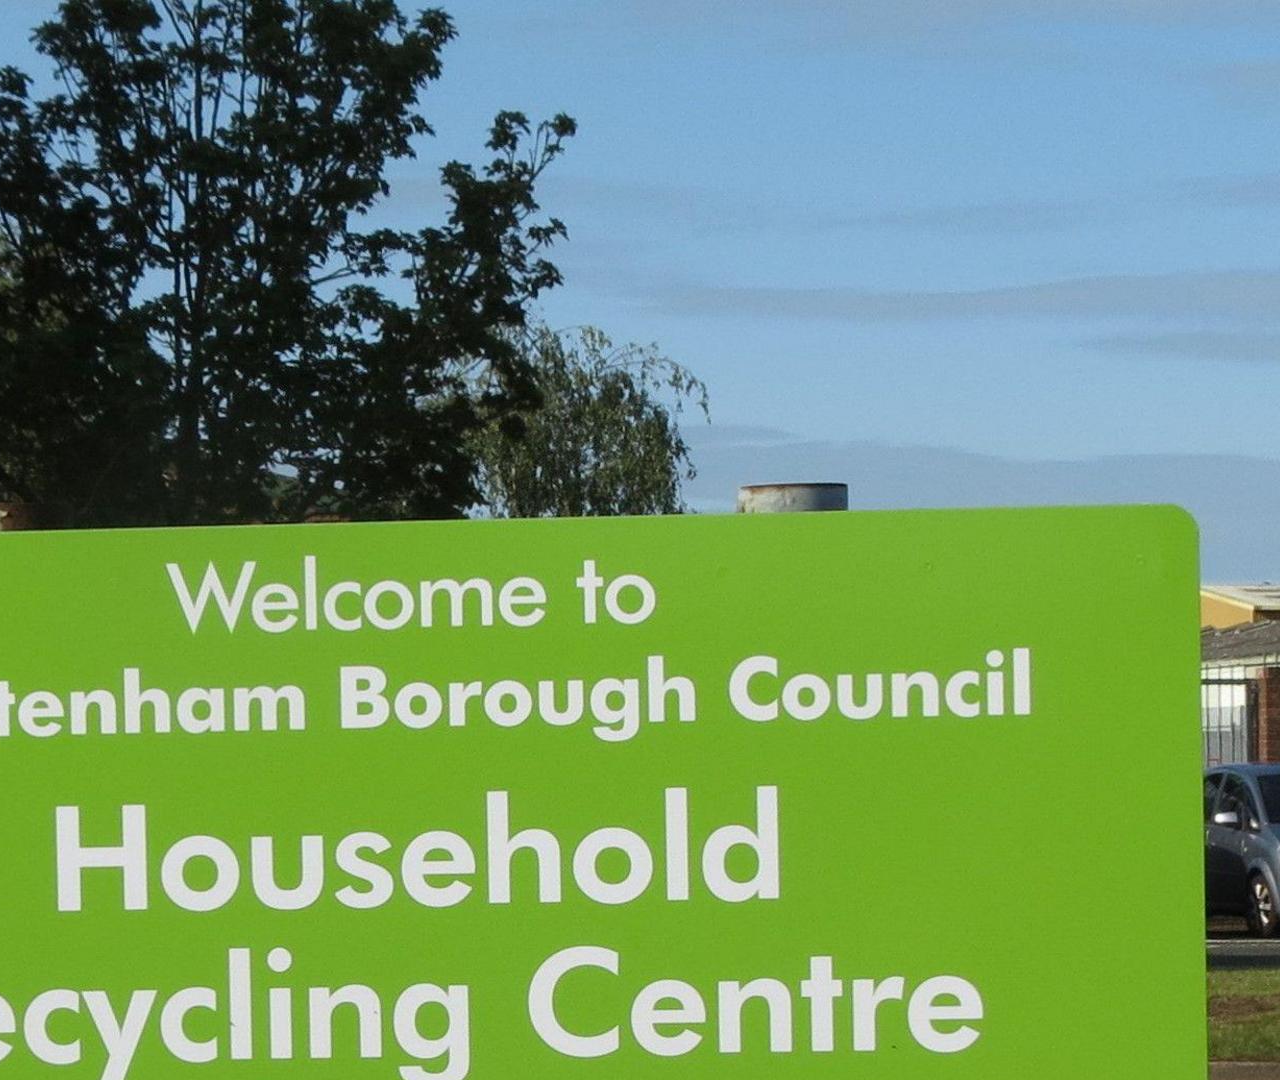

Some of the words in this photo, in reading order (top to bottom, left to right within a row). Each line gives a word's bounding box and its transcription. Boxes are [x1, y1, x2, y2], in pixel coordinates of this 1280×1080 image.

[166, 558, 546, 635] Welcome
[576, 560, 656, 624] to
[340, 655, 696, 741] Borough
[729, 648, 1031, 721] Council
[56, 786, 779, 912] Household
[528, 946, 983, 1057] Centre
